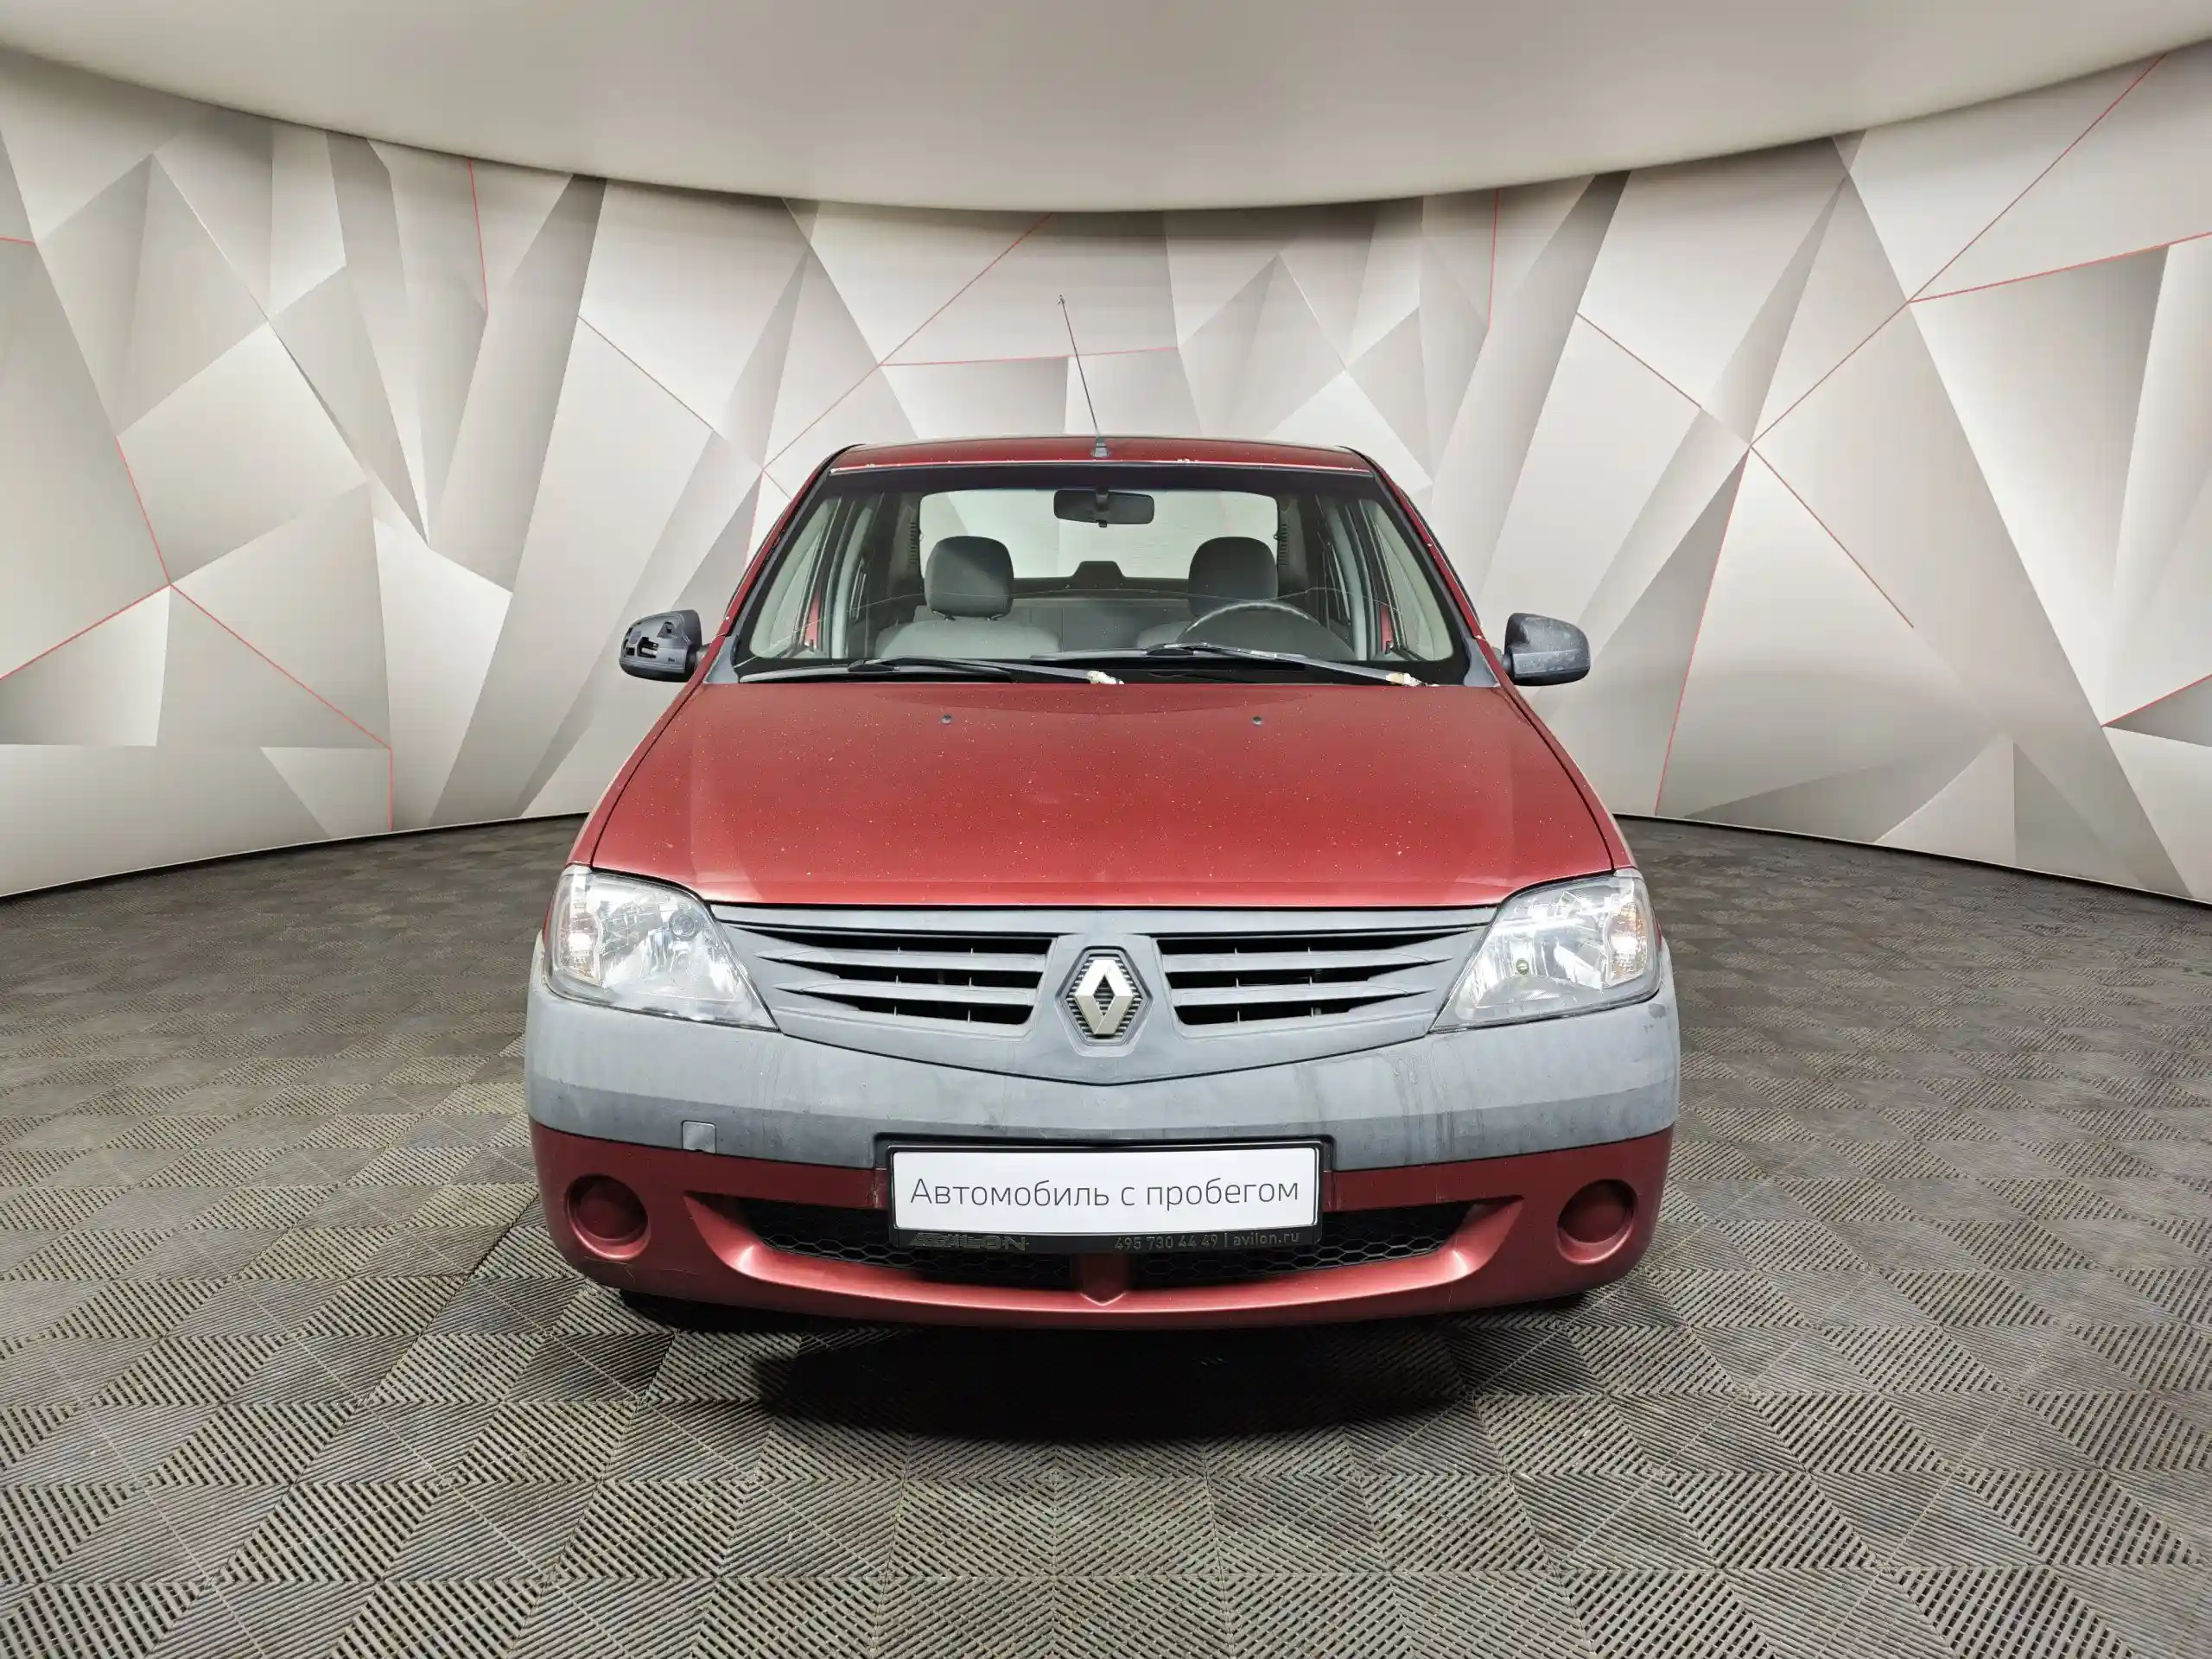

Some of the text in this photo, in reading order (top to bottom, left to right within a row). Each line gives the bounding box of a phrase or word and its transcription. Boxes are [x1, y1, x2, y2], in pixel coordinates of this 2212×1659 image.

[910, 1177, 1299, 1211] Автомобиль с пробегом
[1114, 1236, 1141, 1251] 495
[1147, 1236, 1173, 1250] 730
[1178, 1235, 1198, 1249] 44
[1233, 1230, 1300, 1247] avilon.ru
